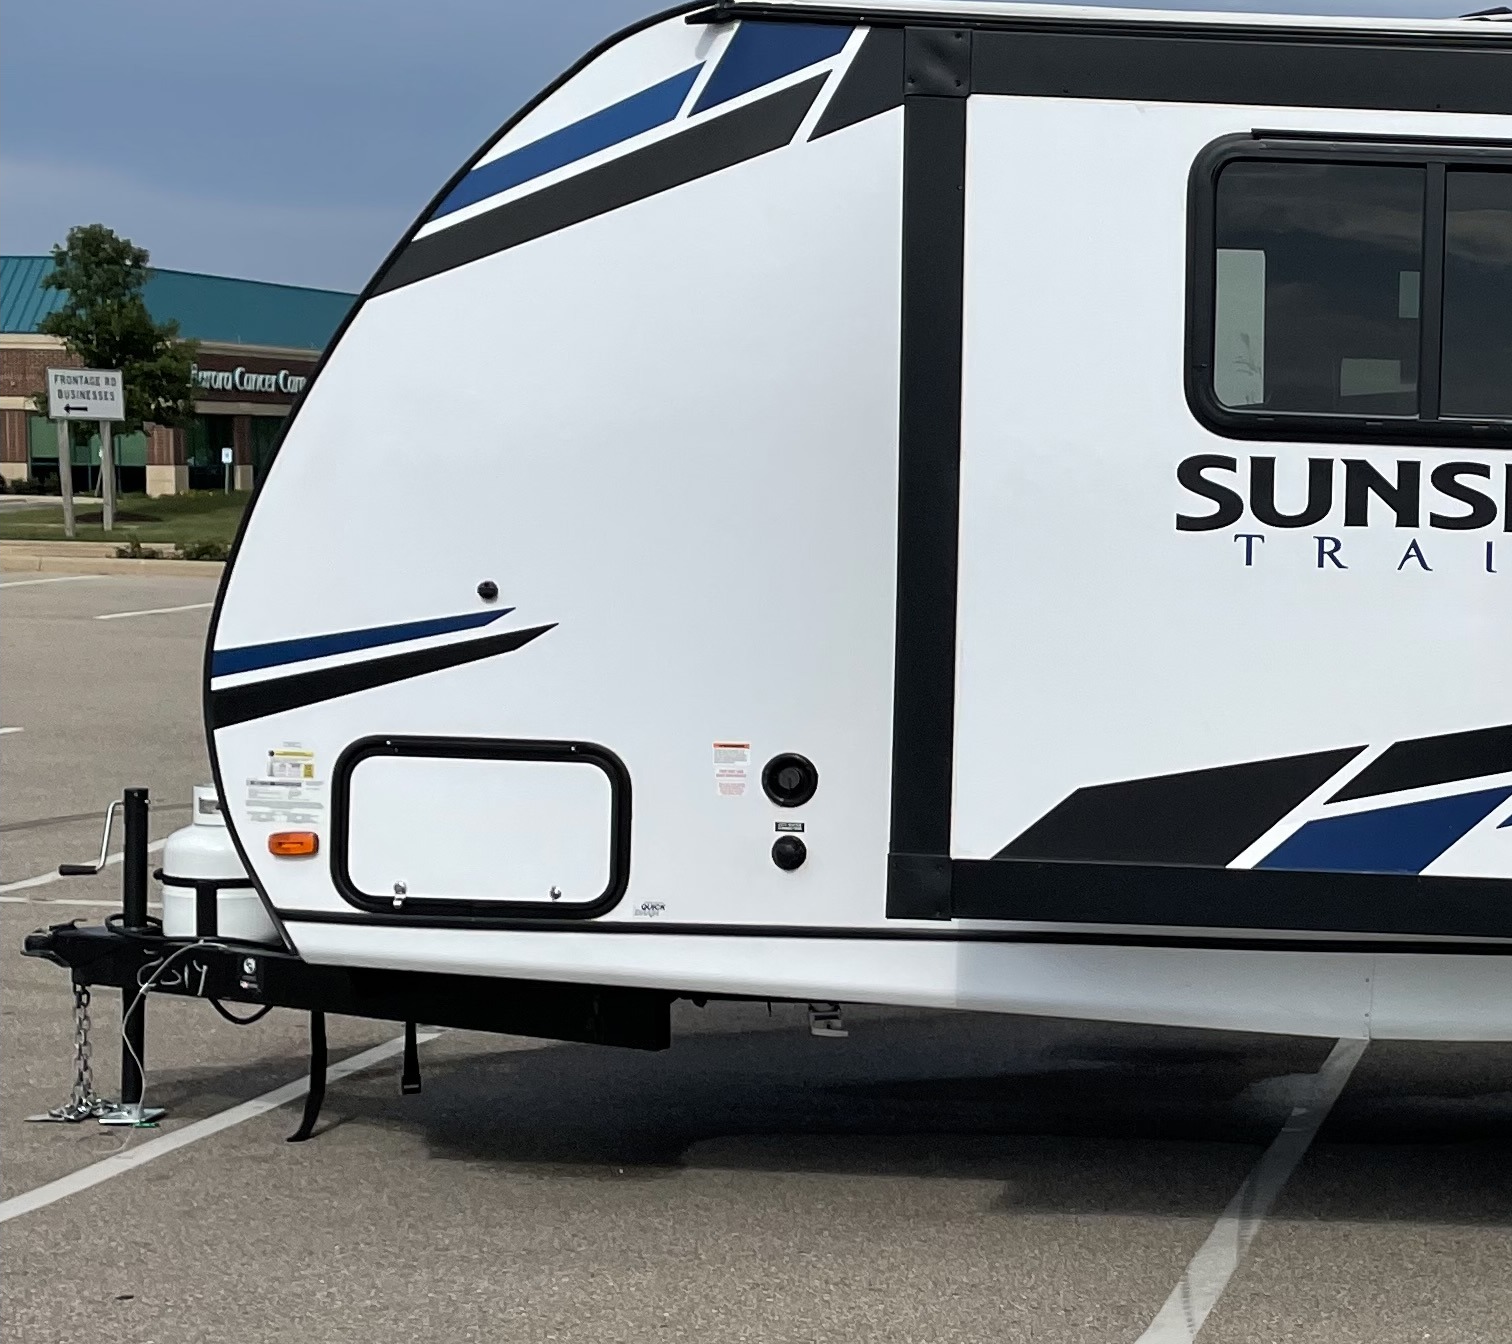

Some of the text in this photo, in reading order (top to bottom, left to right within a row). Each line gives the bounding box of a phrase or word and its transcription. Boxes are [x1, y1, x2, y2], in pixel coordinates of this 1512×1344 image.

[54, 374, 117, 387] FRONTAGE RD
[234, 366, 276, 393] Cancer
[57, 388, 115, 402] BUSINESSES
